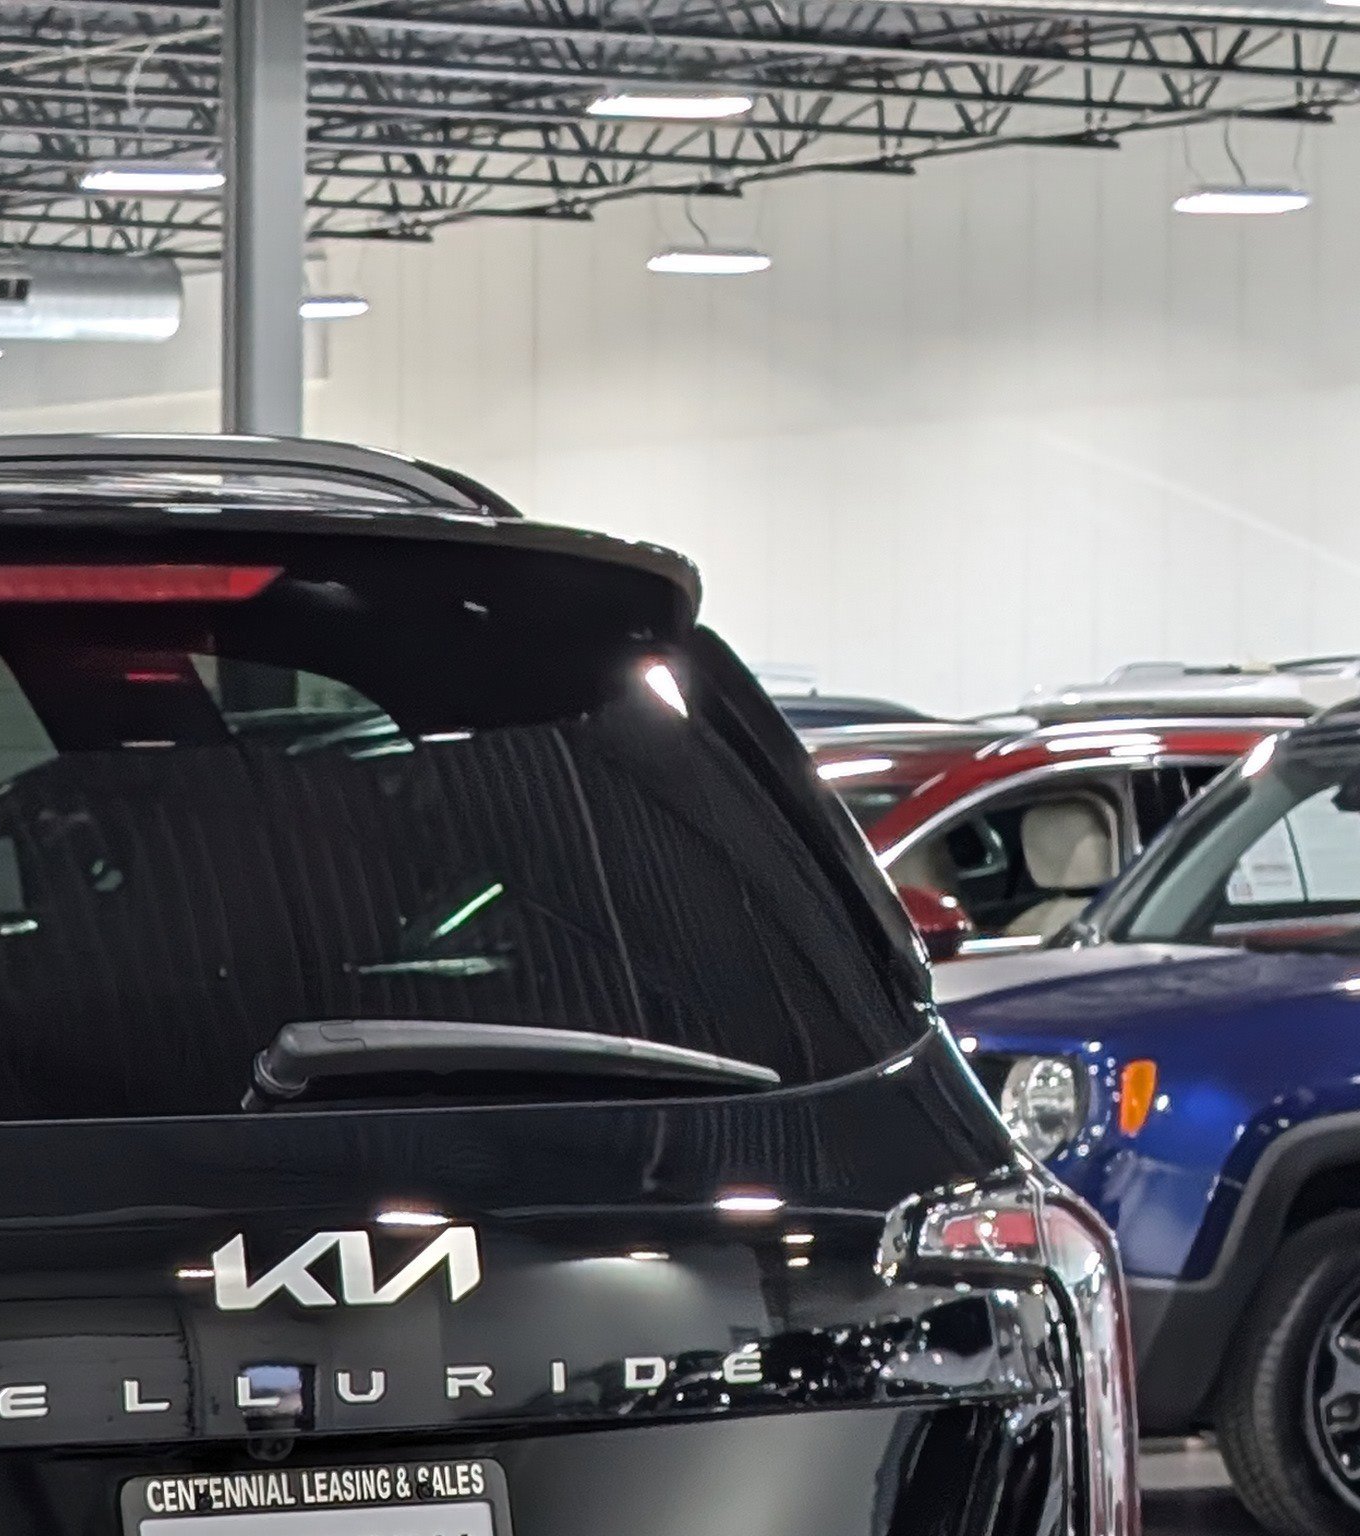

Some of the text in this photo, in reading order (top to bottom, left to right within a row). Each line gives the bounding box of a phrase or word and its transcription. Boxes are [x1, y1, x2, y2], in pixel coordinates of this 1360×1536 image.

[212, 1226, 481, 1311] KIA
[301, 1468, 391, 1504] LEASING
[396, 1465, 411, 1498] &
